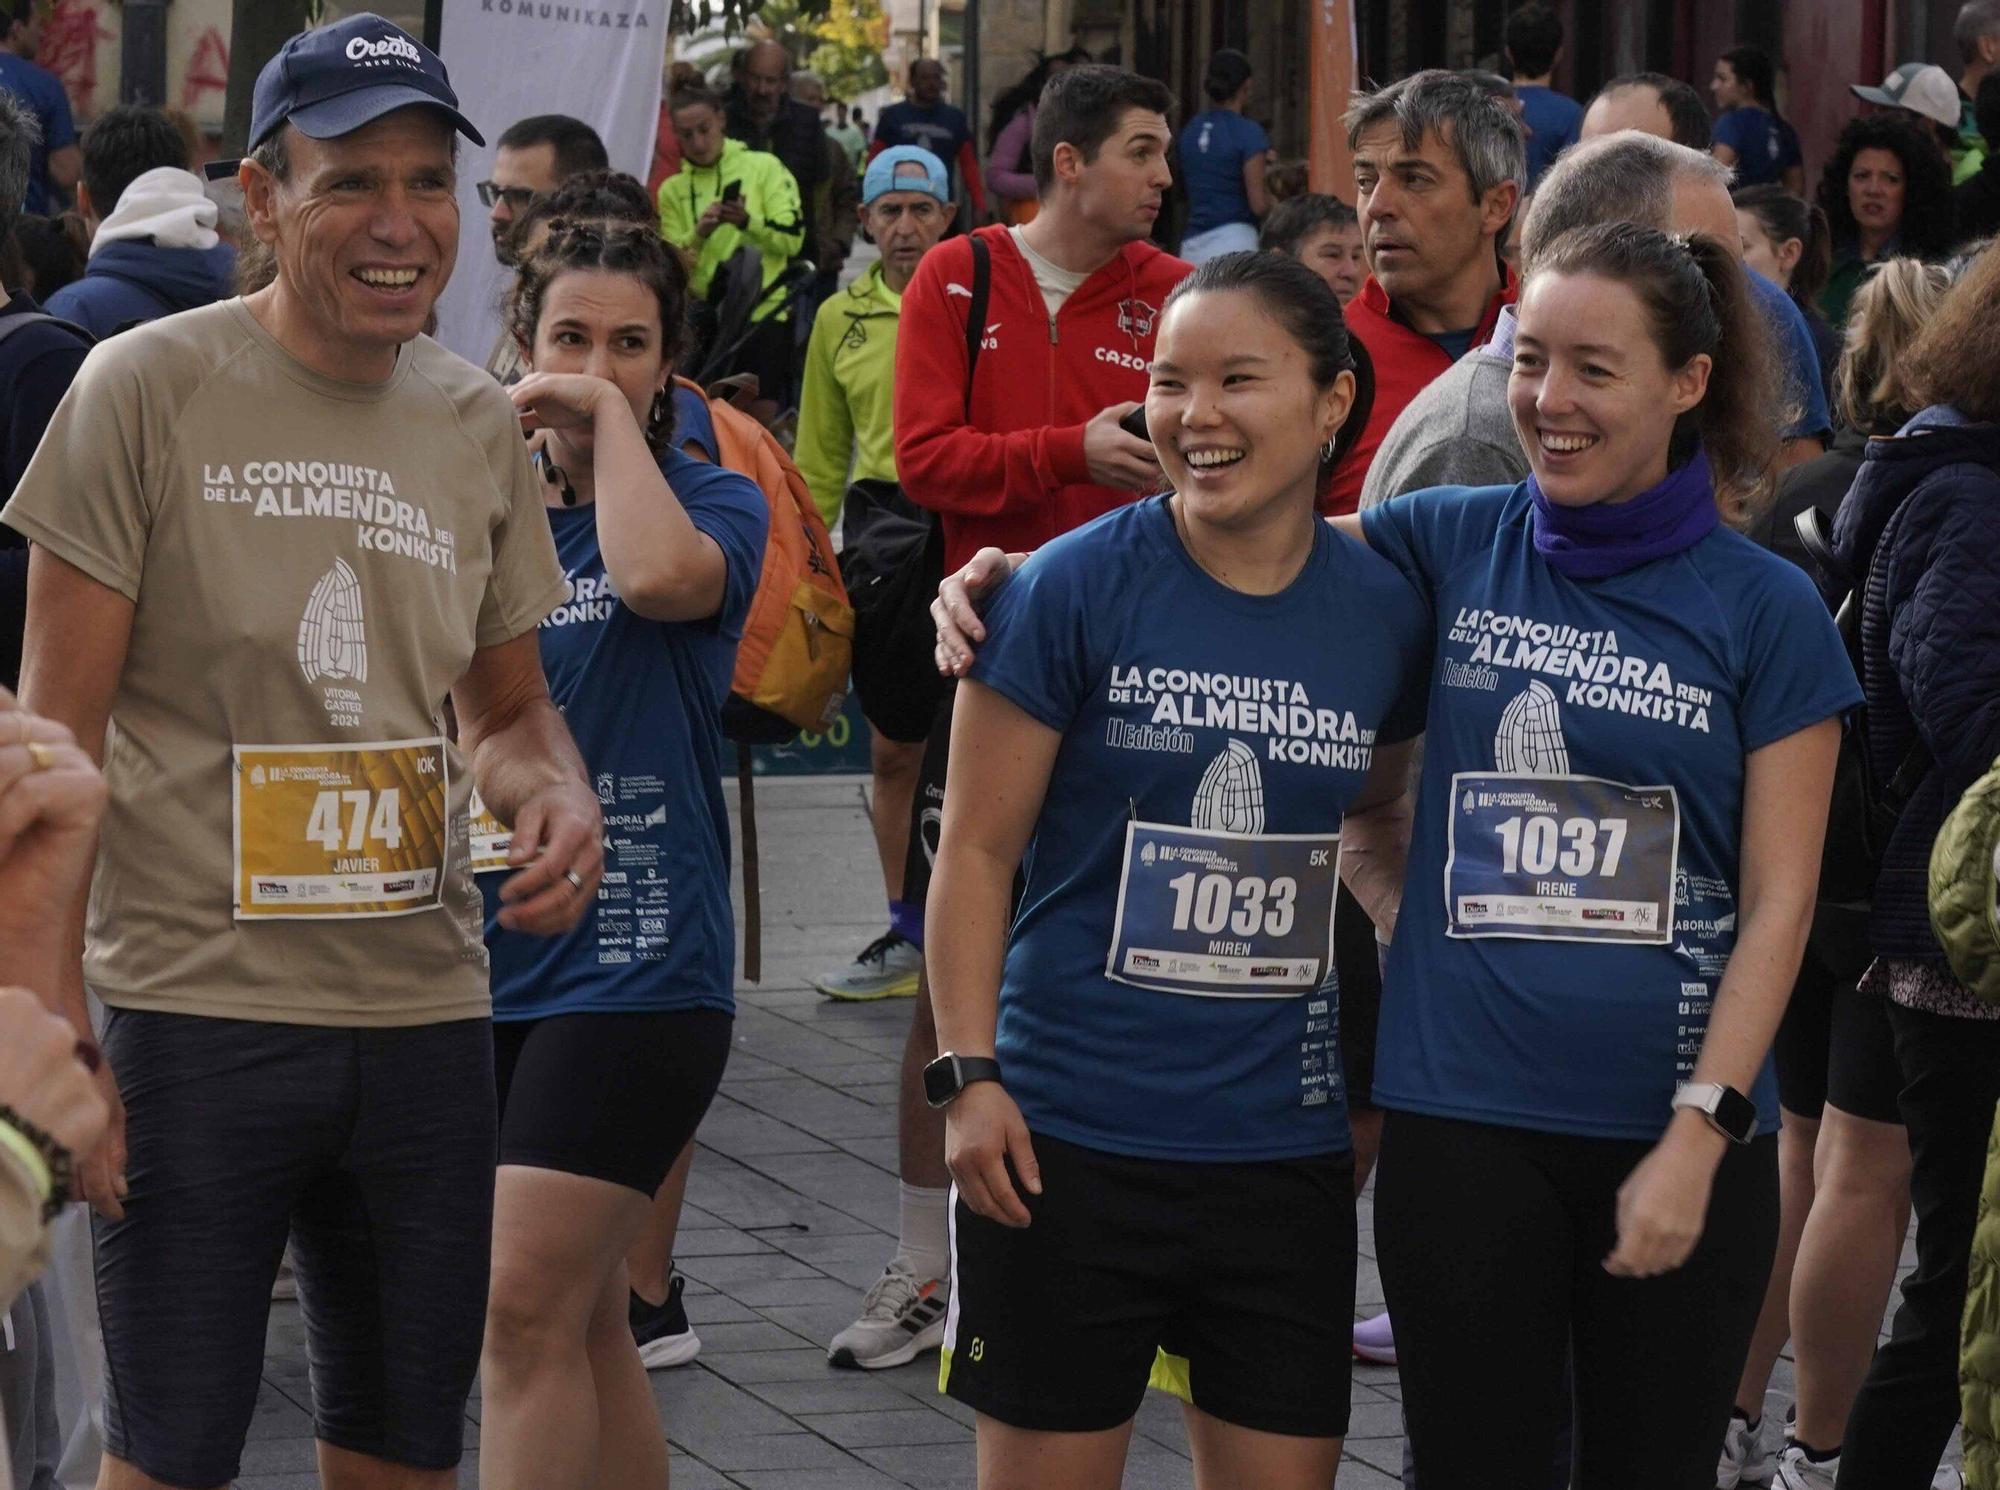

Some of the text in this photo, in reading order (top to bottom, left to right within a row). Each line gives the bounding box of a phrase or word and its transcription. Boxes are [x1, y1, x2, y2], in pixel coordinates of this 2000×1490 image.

[482, 0, 649, 28] KOMUNIKAZA
[345, 35, 421, 64] Create
[204, 461, 395, 495] LA CONQUISTA
[203, 487, 226, 502] DE
[231, 488, 253, 503] LA
[254, 487, 431, 538] ALMENDRA
[357, 524, 457, 576] KONKISTA
[1454, 607, 1619, 654] LA CONQUISTA
[1448, 627, 1712, 707] DE LA ALMENDRA REN
[1449, 664, 1499, 691] Edición
[324, 687, 361, 701] VITORIA
[1110, 666, 1310, 706] LA CONQUISTA
[324, 700, 364, 713] GASTEIZ
[330, 714, 360, 727] 2024
[1108, 688, 1131, 703] DE
[1134, 689, 1156, 704] LA
[1151, 693, 1360, 744] ALMENDRA
[1565, 681, 1711, 733] KONKISTA
[1106, 717, 1194, 754] II Edición
[416, 756, 436, 775] 10K
[1268, 737, 1373, 771] KONKISTA
[306, 788, 403, 851] 474
[1309, 849, 1329, 867] 5K
[1495, 816, 1628, 877] 1037
[333, 857, 380, 873] JAVIER
[1168, 872, 1298, 937] 1033
[1536, 881, 1577, 897] IRENE
[1673, 919, 1715, 932] ABORAL
[1208, 940, 1252, 957] MIREN
